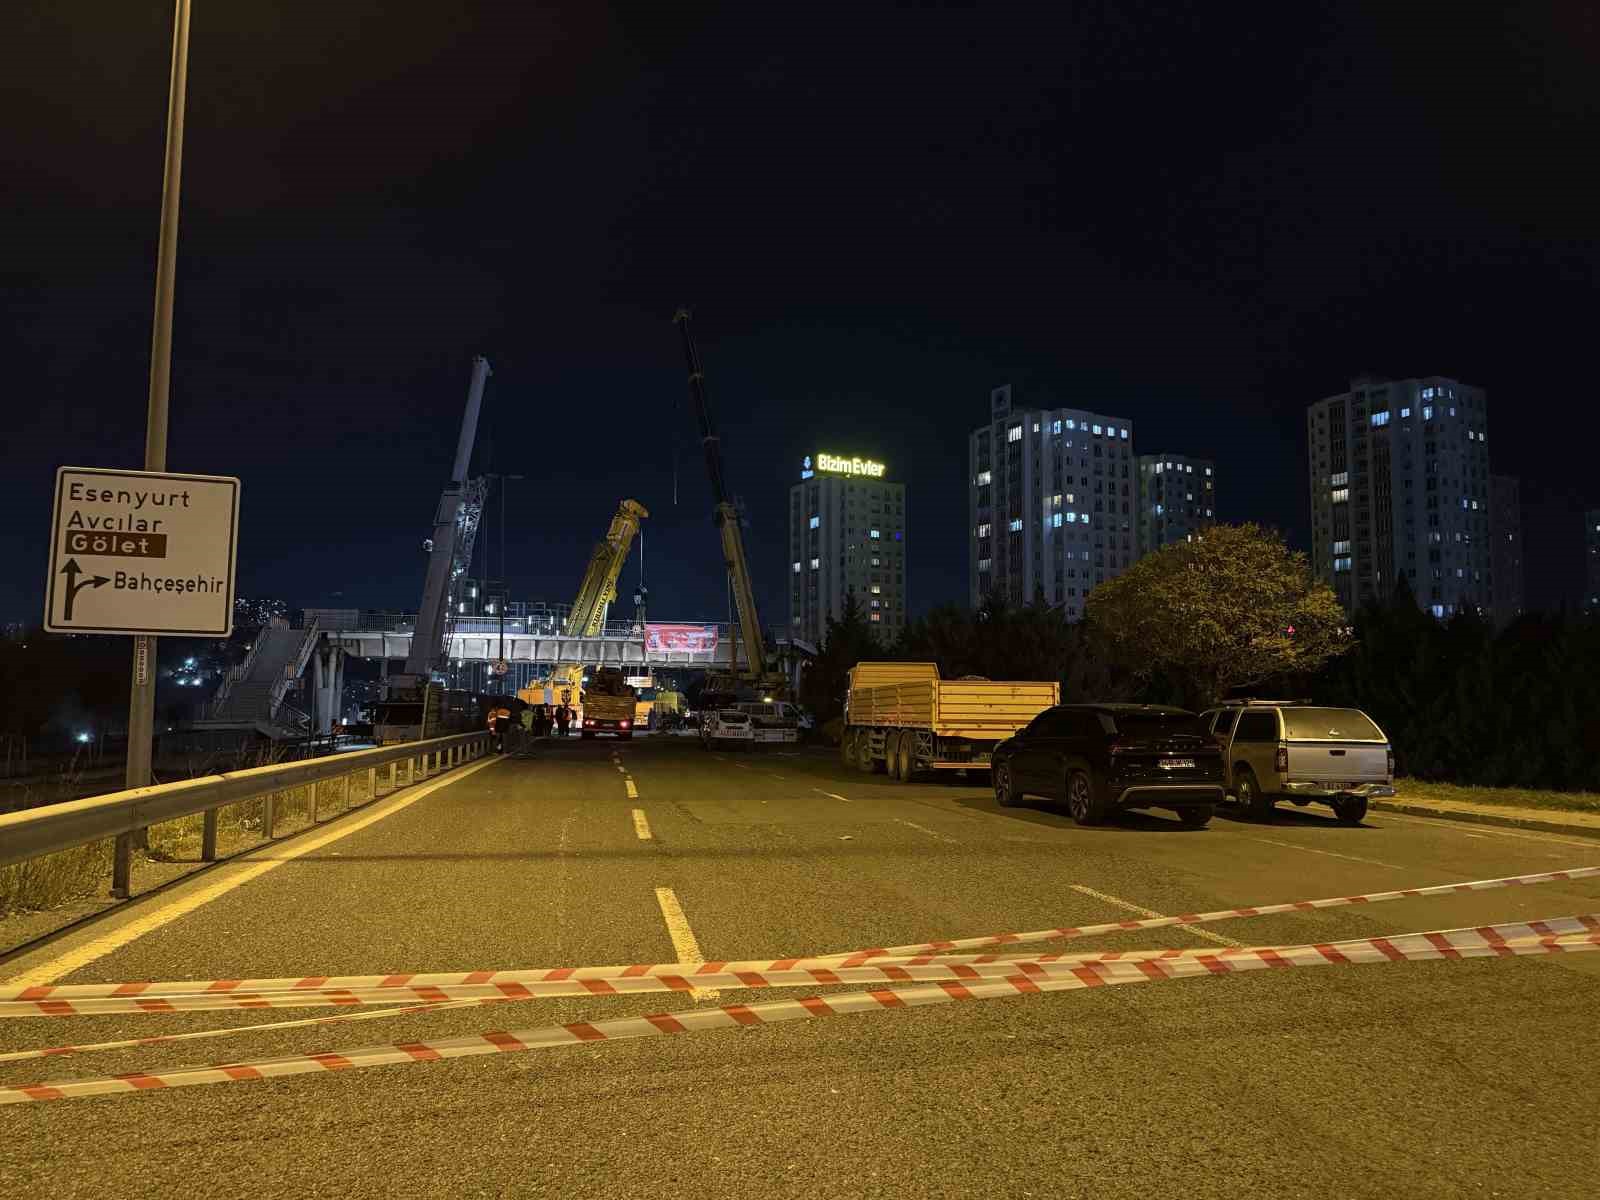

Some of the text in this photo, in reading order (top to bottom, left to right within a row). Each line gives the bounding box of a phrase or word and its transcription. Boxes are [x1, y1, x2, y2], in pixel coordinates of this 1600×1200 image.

[818, 454, 851, 473] Bizim
[70, 483, 191, 509] Esenyurt
[68, 510, 163, 532] Avcılar
[71, 533, 150, 554] Gölet
[114, 572, 224, 595] Bahçeşehir
